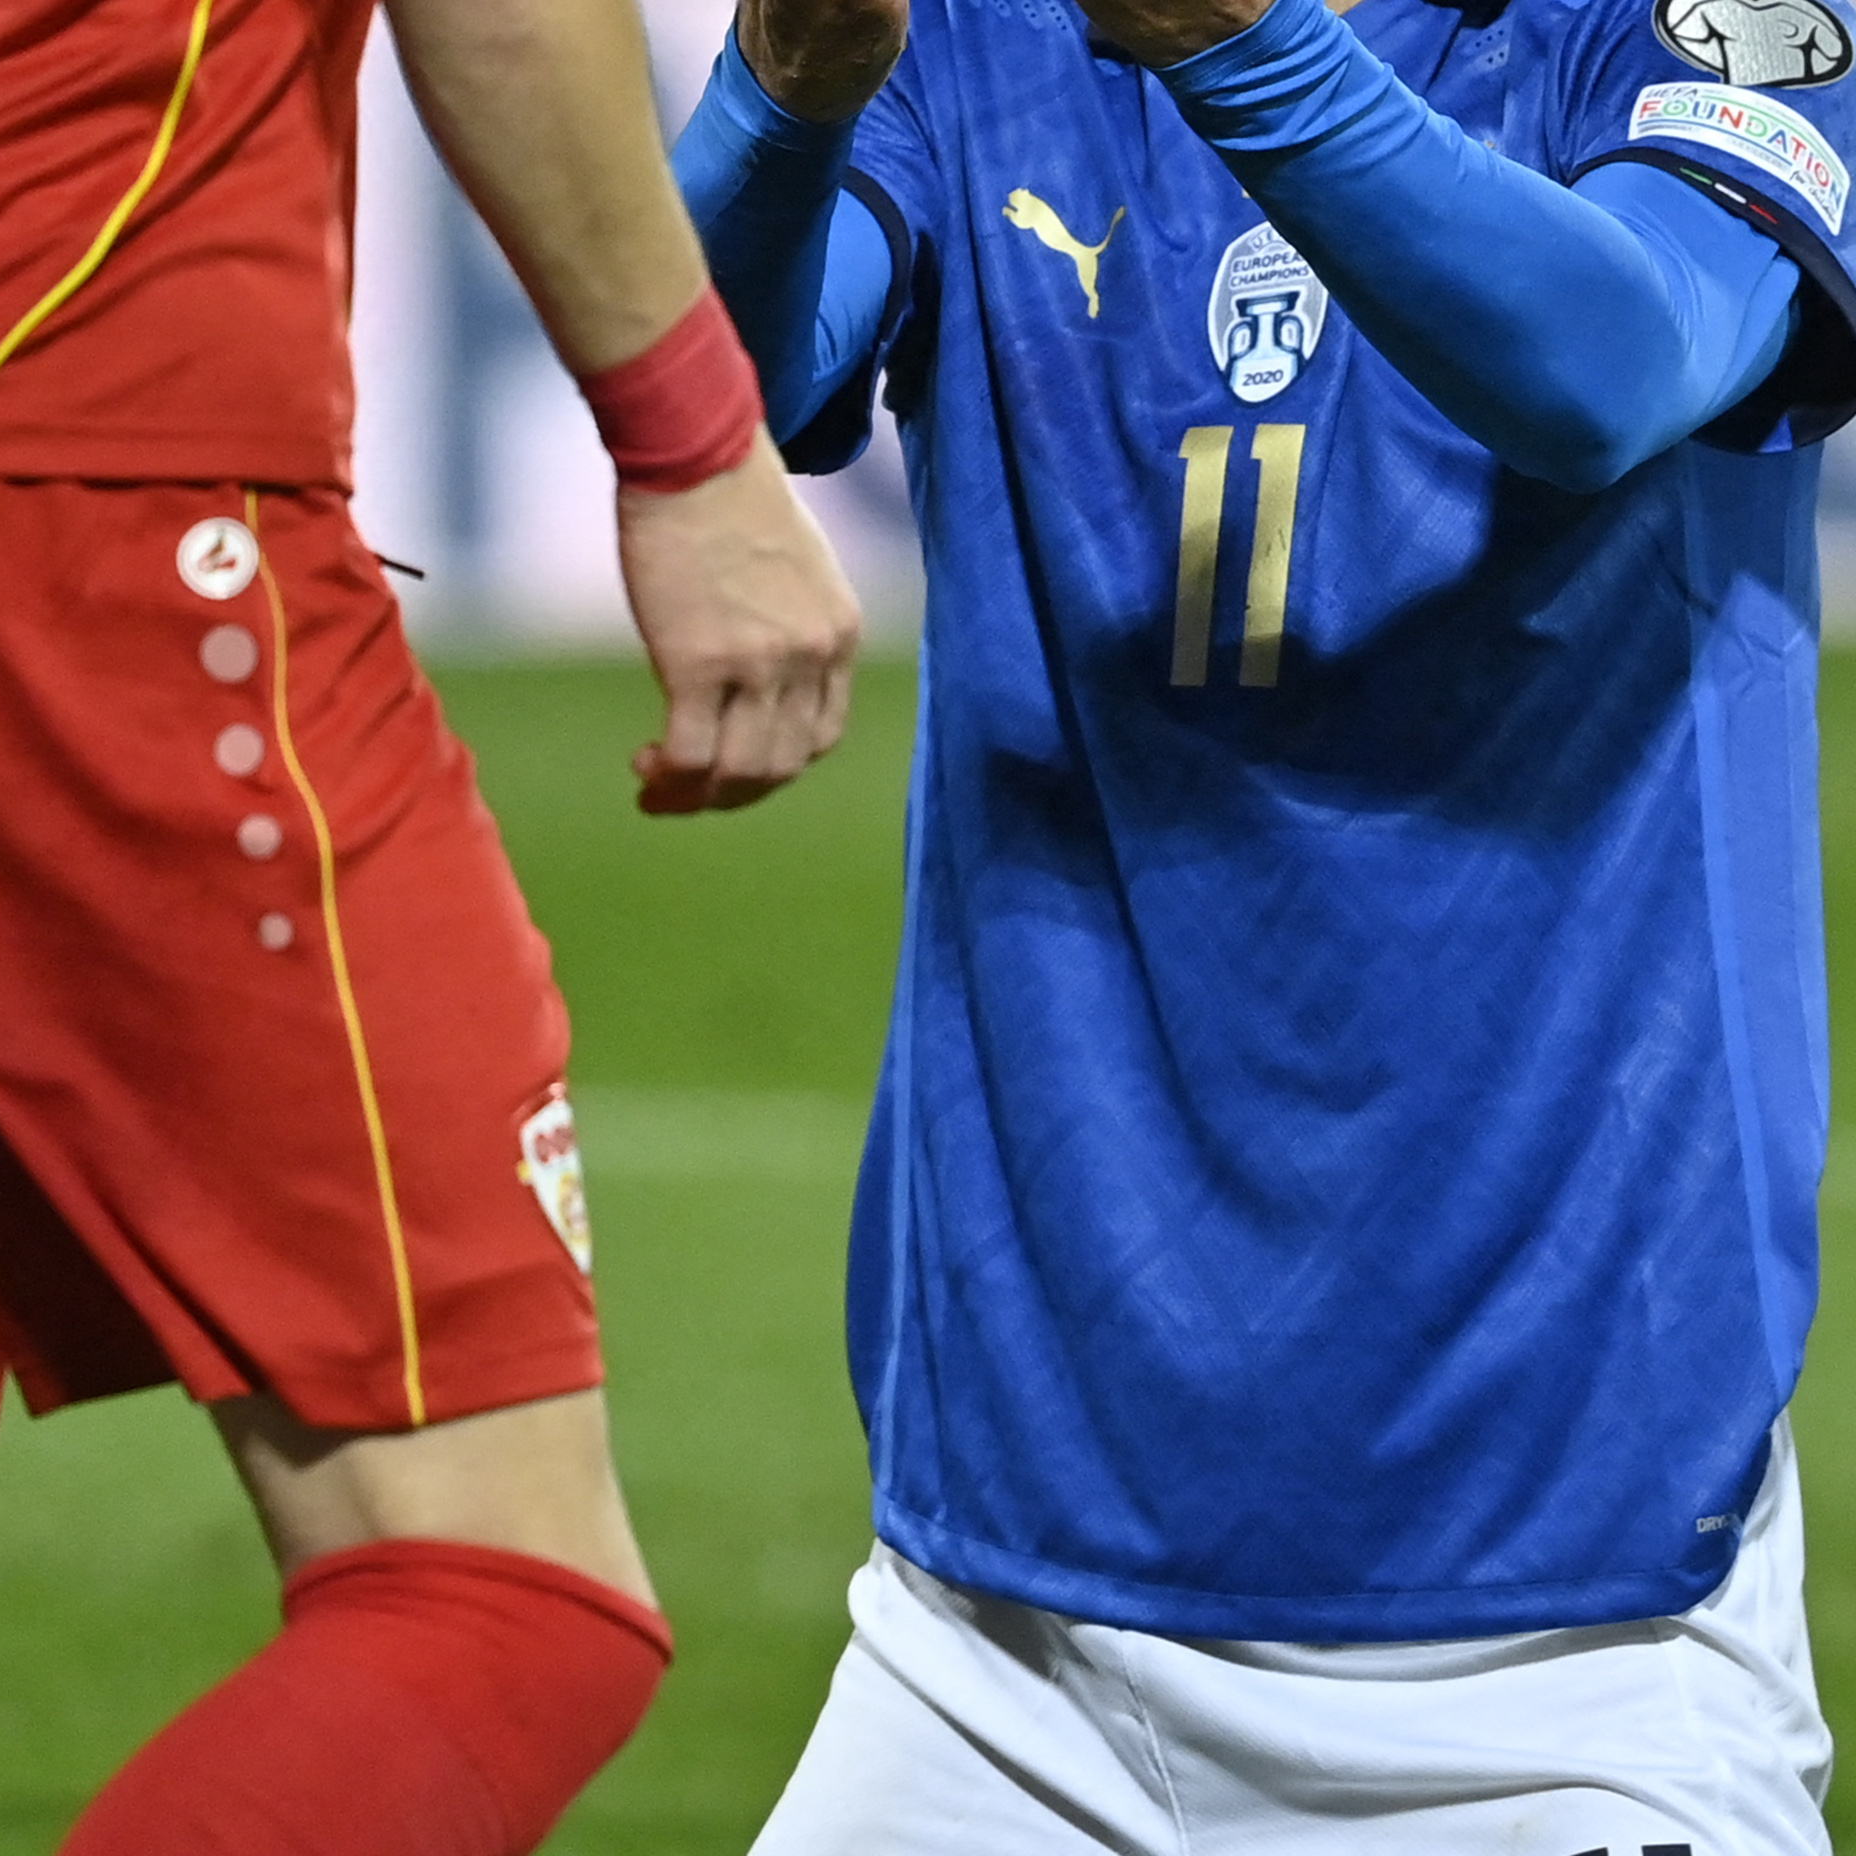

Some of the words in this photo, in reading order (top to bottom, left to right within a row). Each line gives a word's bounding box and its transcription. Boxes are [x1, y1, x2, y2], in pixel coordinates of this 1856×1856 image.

[1638, 99, 1842, 211] FOUNDATION
[1232, 251, 1304, 275] EUROPEA
[1230, 265, 1310, 288] CHAMPIONS
[1243, 368, 1284, 387] 2020
[1170, 423, 1306, 687] 11
